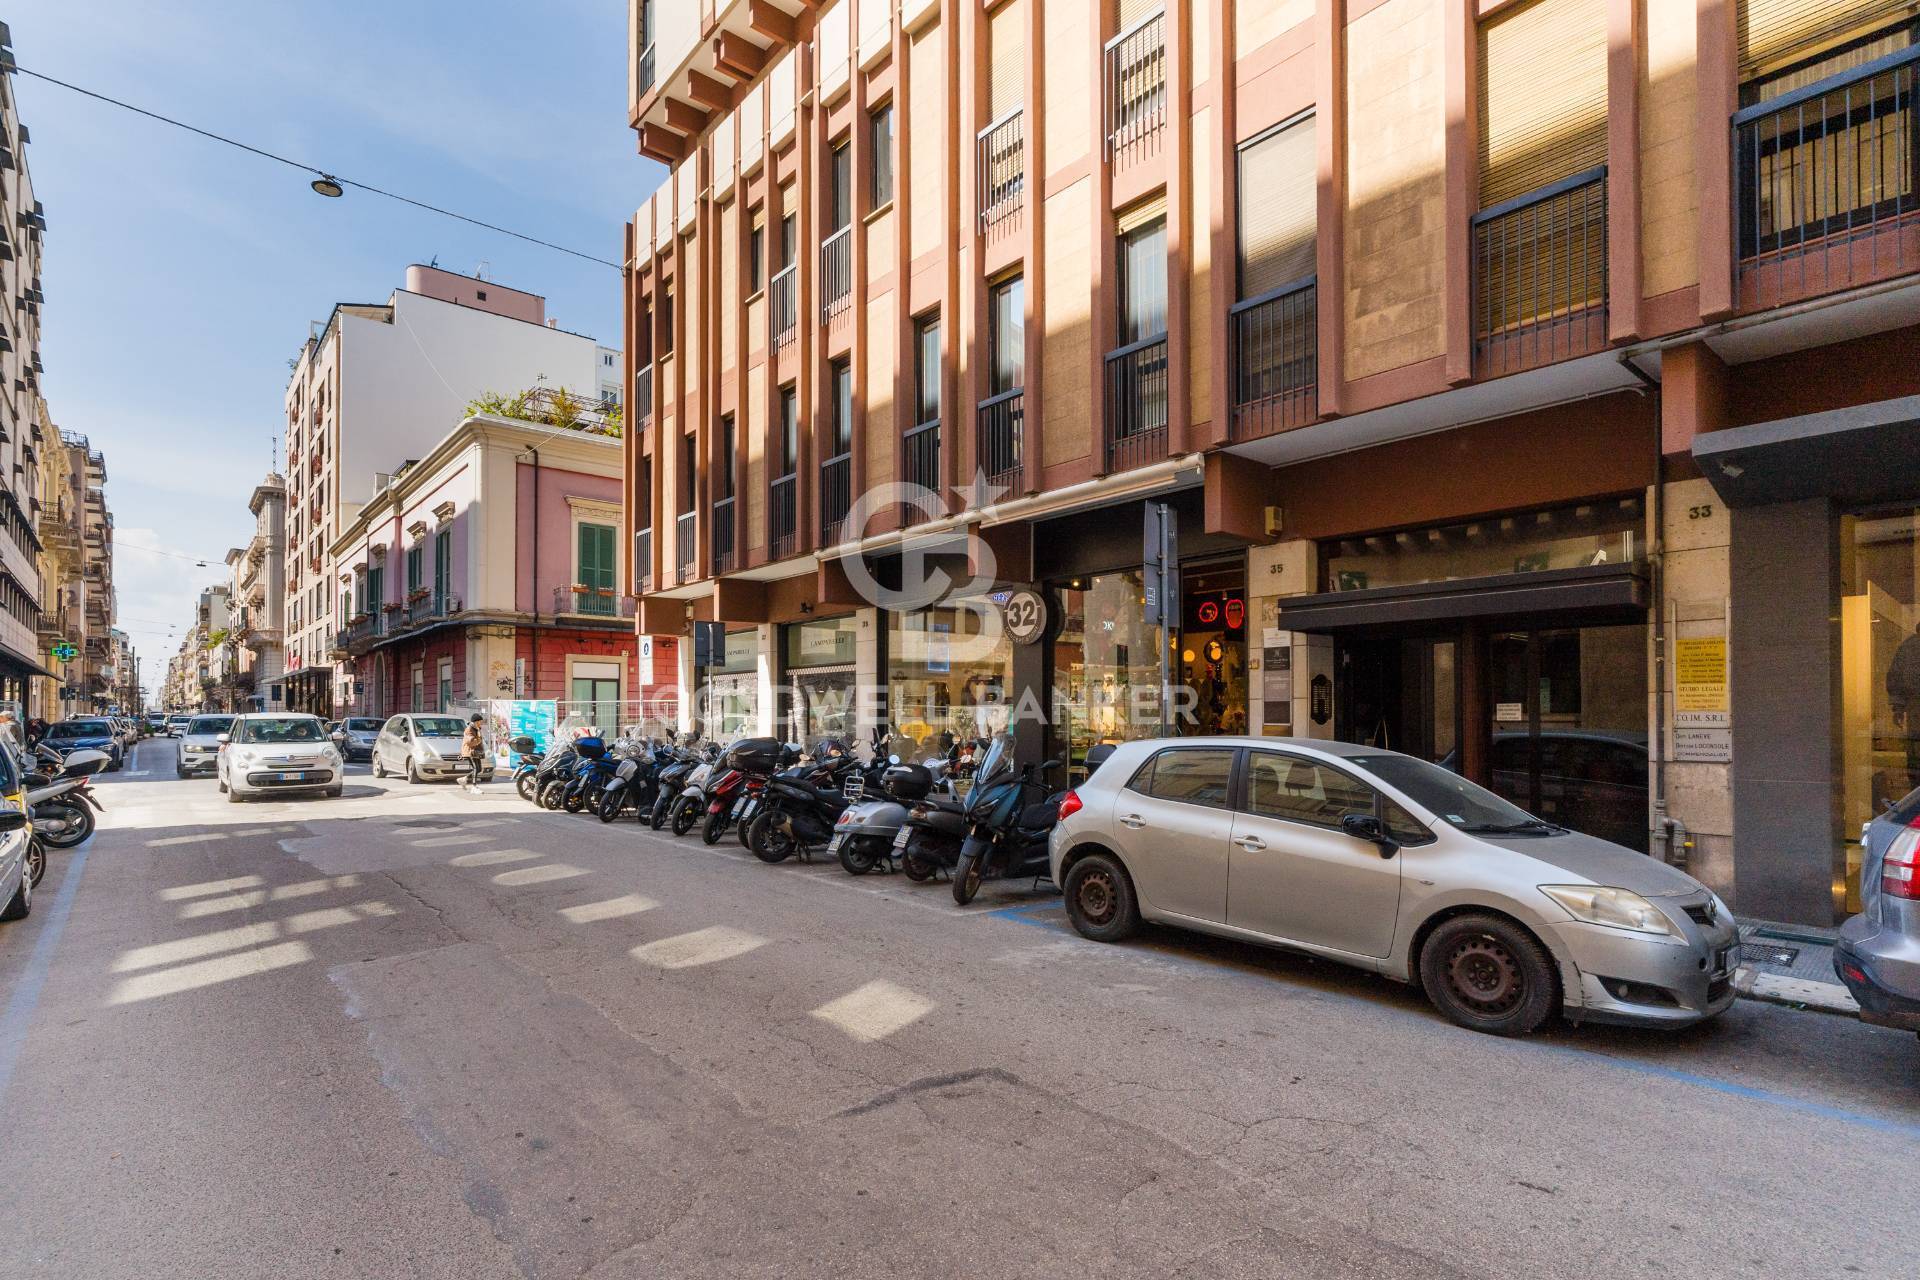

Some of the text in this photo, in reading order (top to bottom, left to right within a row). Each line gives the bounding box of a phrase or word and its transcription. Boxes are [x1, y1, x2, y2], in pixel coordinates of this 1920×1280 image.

[1689, 504, 1711, 520] 33
[1270, 564, 1283, 574] 35
[1008, 600, 1035, 628] 32
